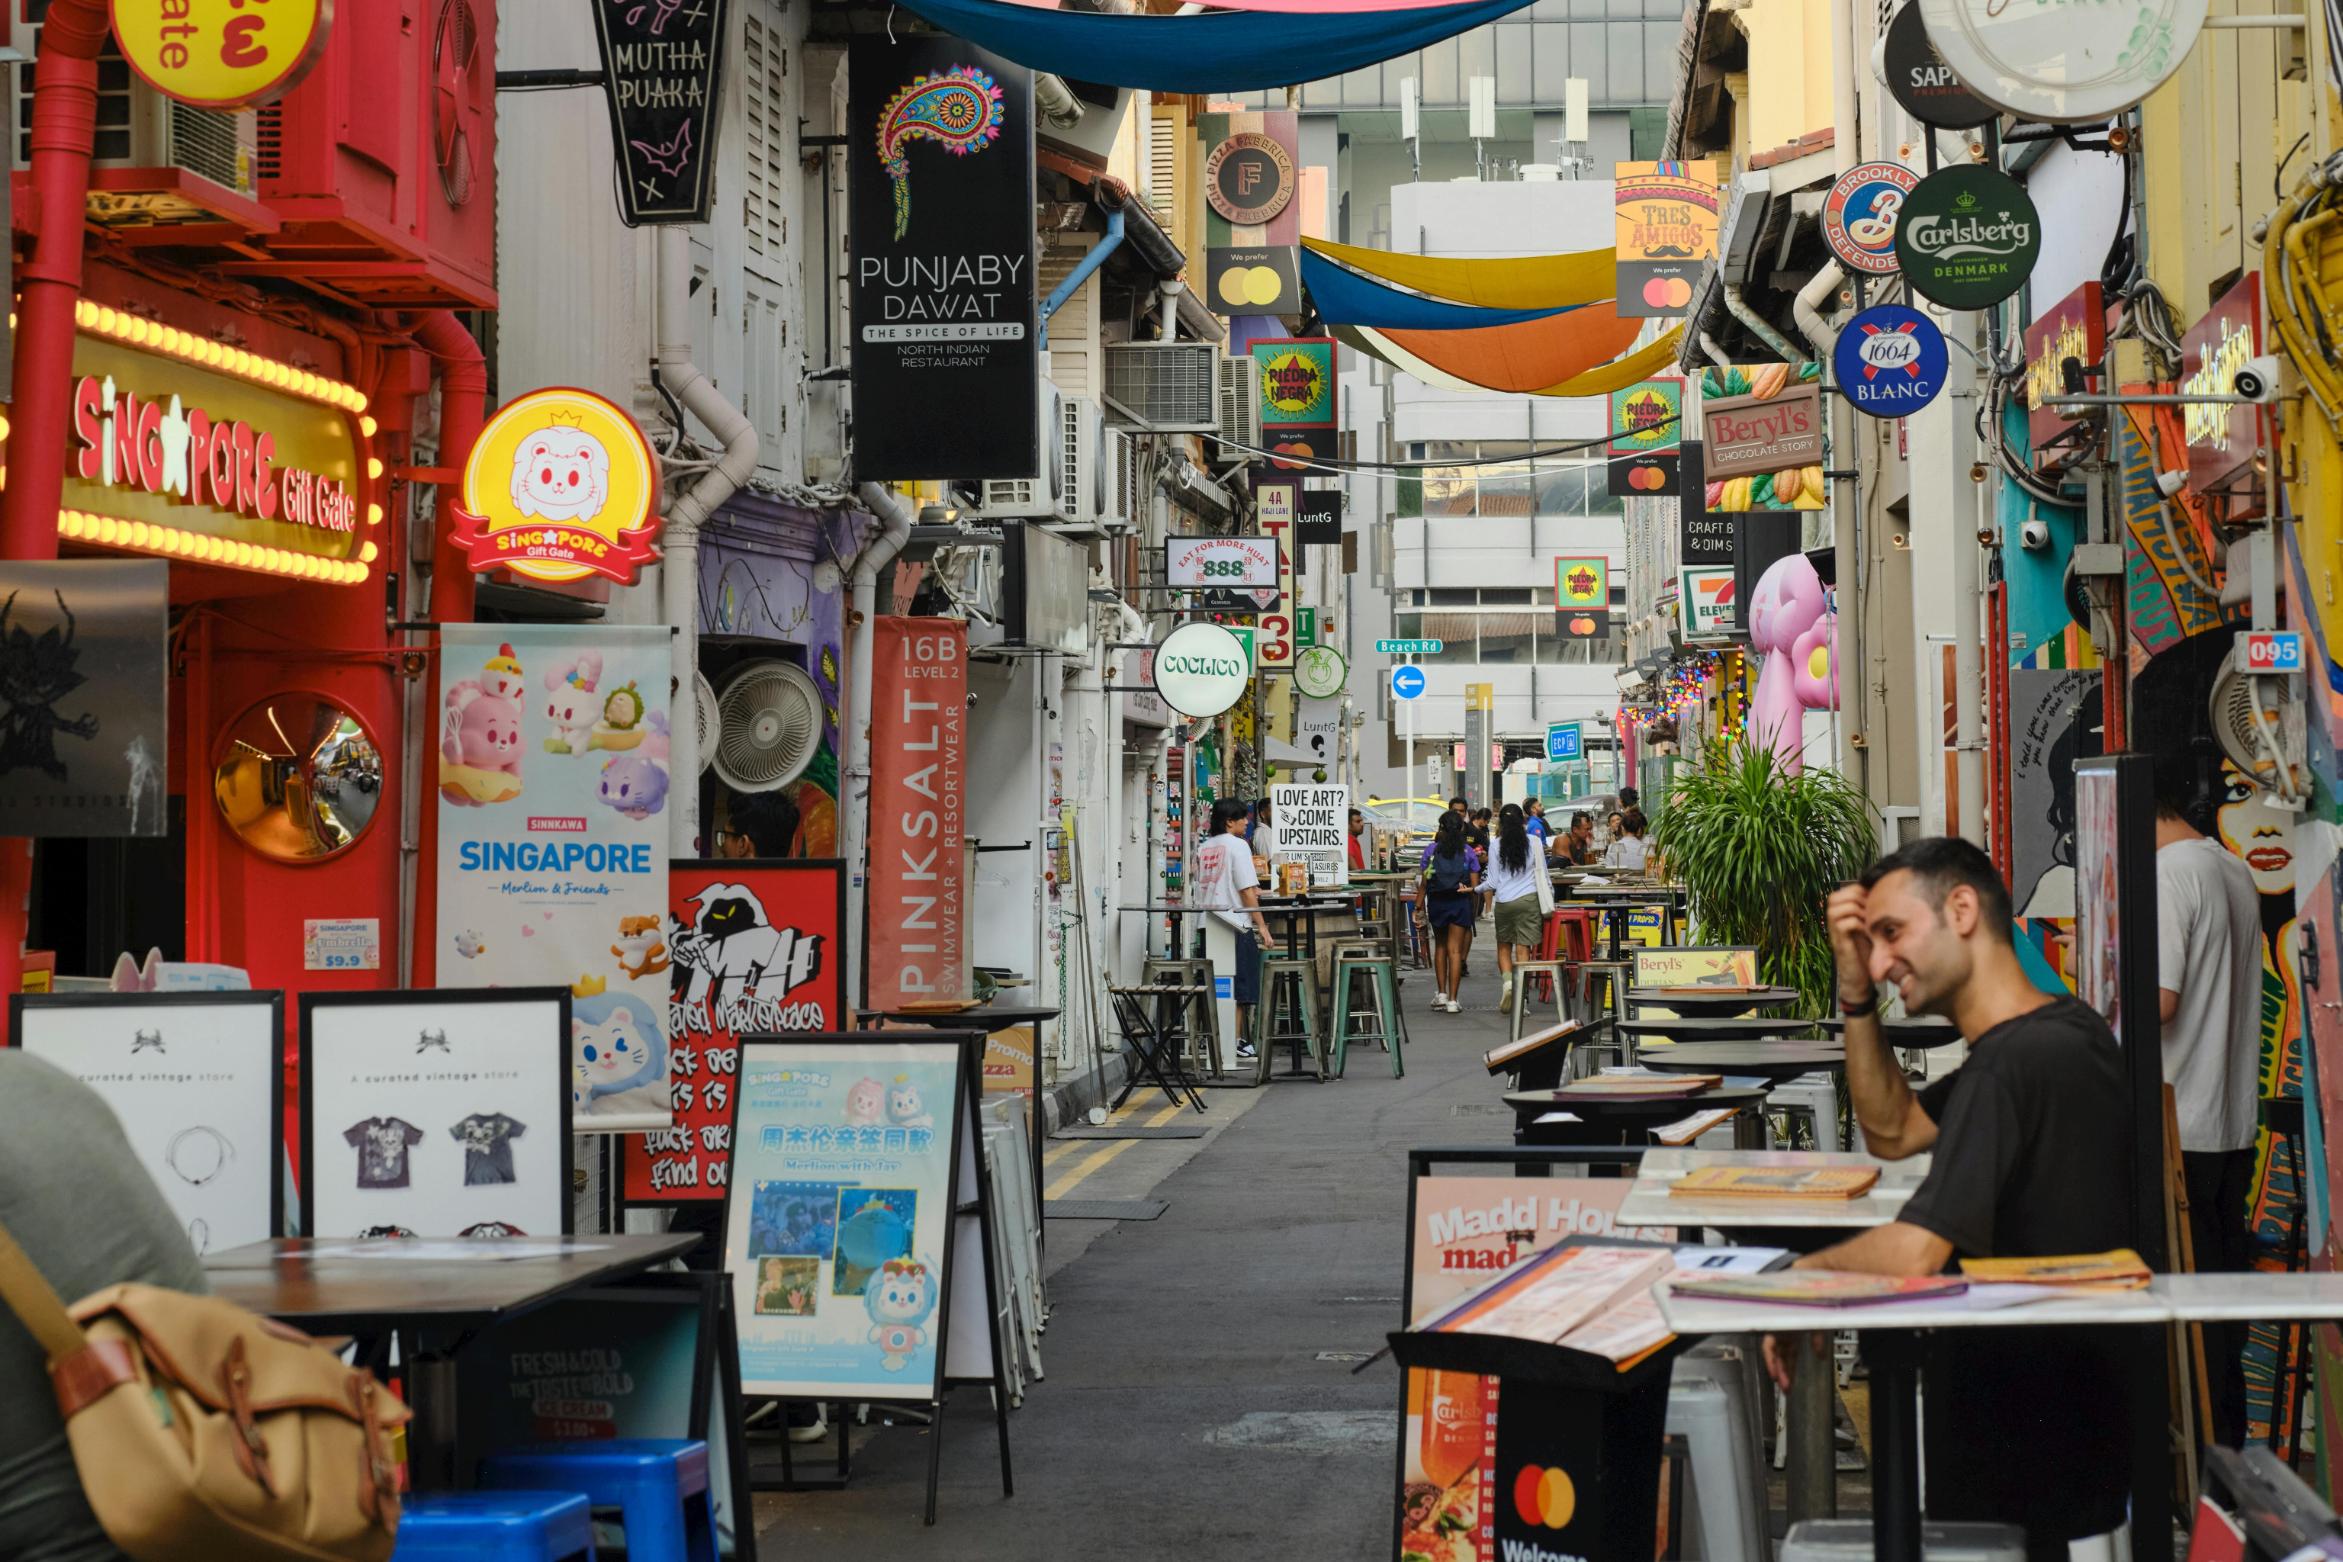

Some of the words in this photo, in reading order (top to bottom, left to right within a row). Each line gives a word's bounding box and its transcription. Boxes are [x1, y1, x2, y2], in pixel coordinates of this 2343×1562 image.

[616, 40, 706, 73] MUTHA
[619, 75, 703, 109] PUAKA
[1837, 166, 1916, 197] BROOKLY
[1641, 204, 1691, 226] TRES
[1630, 223, 1703, 248] AMIGOS
[1906, 214, 2030, 254] Carlsberg
[1245, 253, 1268, 262] prefer
[1831, 228, 1898, 270] DEFENDE
[861, 254, 1024, 293] PUNJABY
[1934, 262, 2008, 278] DENMARK
[884, 293, 1002, 320] DAWAT
[868, 329, 896, 338] THE
[905, 328, 949, 337] SPICE
[959, 327, 977, 336] OF
[986, 326, 1019, 336] LIFE
[897, 345, 943, 355] NORTH
[946, 344, 990, 354] INDIAN
[1868, 340, 1912, 361] 1664
[901, 356, 986, 368] RESTAURANT
[1268, 367, 1318, 383] PIEDRA
[1271, 385, 1314, 400] NEGRA
[1857, 381, 1929, 401] BLANC
[1626, 402, 1669, 415] PIEDRA
[1712, 404, 1809, 446] Beryl's
[1717, 445, 1779, 462] CHOCOLATE
[1782, 440, 1813, 453] STORY
[282, 466, 315, 526] Gift
[316, 474, 355, 533] Gate
[1269, 491, 1282, 505] 4A
[1276, 507, 1288, 515] LANE
[1297, 512, 1332, 523] LuntG
[1689, 521, 1723, 534] CRAFT
[527, 546, 547, 557] Gift
[549, 547, 575, 560] Gate
[1691, 538, 1700, 549] &
[1703, 539, 1724, 551] DIM
[1178, 551, 1194, 568] EAT
[1195, 541, 1214, 554] FOR
[1216, 540, 1245, 550] MORE
[1247, 546, 1270, 567] HUAT
[1203, 560, 1244, 577] 888
[1569, 584, 1595, 593] NEGRA
[902, 635, 958, 662] 16B
[1381, 641, 1417, 651] Beach
[1422, 641, 1436, 651] Rd
[2250, 641, 2297, 662] 095
[905, 666, 947, 678] LEVEL
[951, 666, 959, 678] 2
[1164, 655, 1240, 677] COCLICO
[1303, 721, 1336, 733] LuntG
[1553, 737, 1565, 750] ECP
[2019, 740, 2031, 768] told
[2026, 715, 2041, 741] you
[944, 705, 959, 848] RESORTWEAR
[1277, 789, 1308, 806] LOVE
[1312, 790, 1344, 807] ART?
[531, 819, 583, 830] SINNKAWA
[1298, 809, 1335, 826] COME
[900, 688, 939, 994] PINKSALT
[1280, 828, 1343, 846] UPSTAIRS.
[459, 840, 652, 874] SINGAPORE
[501, 881, 548, 895] Merlion
[552, 883, 561, 894] &
[563, 881, 610, 896] Friends
[320, 924, 368, 932] SINGAPORE
[943, 876, 957, 994] SWIMWEAR
[326, 954, 360, 968] $9.9
[1640, 956, 1682, 974] Beryl's
[986, 1038, 1034, 1066] Promo
[79, 1072, 133, 1083] curated
[140, 1073, 192, 1083] vintage
[365, 1073, 419, 1083] curated
[425, 1071, 477, 1082] vintage
[483, 1070, 520, 1080] store
[785, 1159, 837, 1171] Merlion
[839, 1160, 874, 1171] with
[876, 1160, 900, 1172] Jay
[1427, 1195, 1540, 1247] Madd
